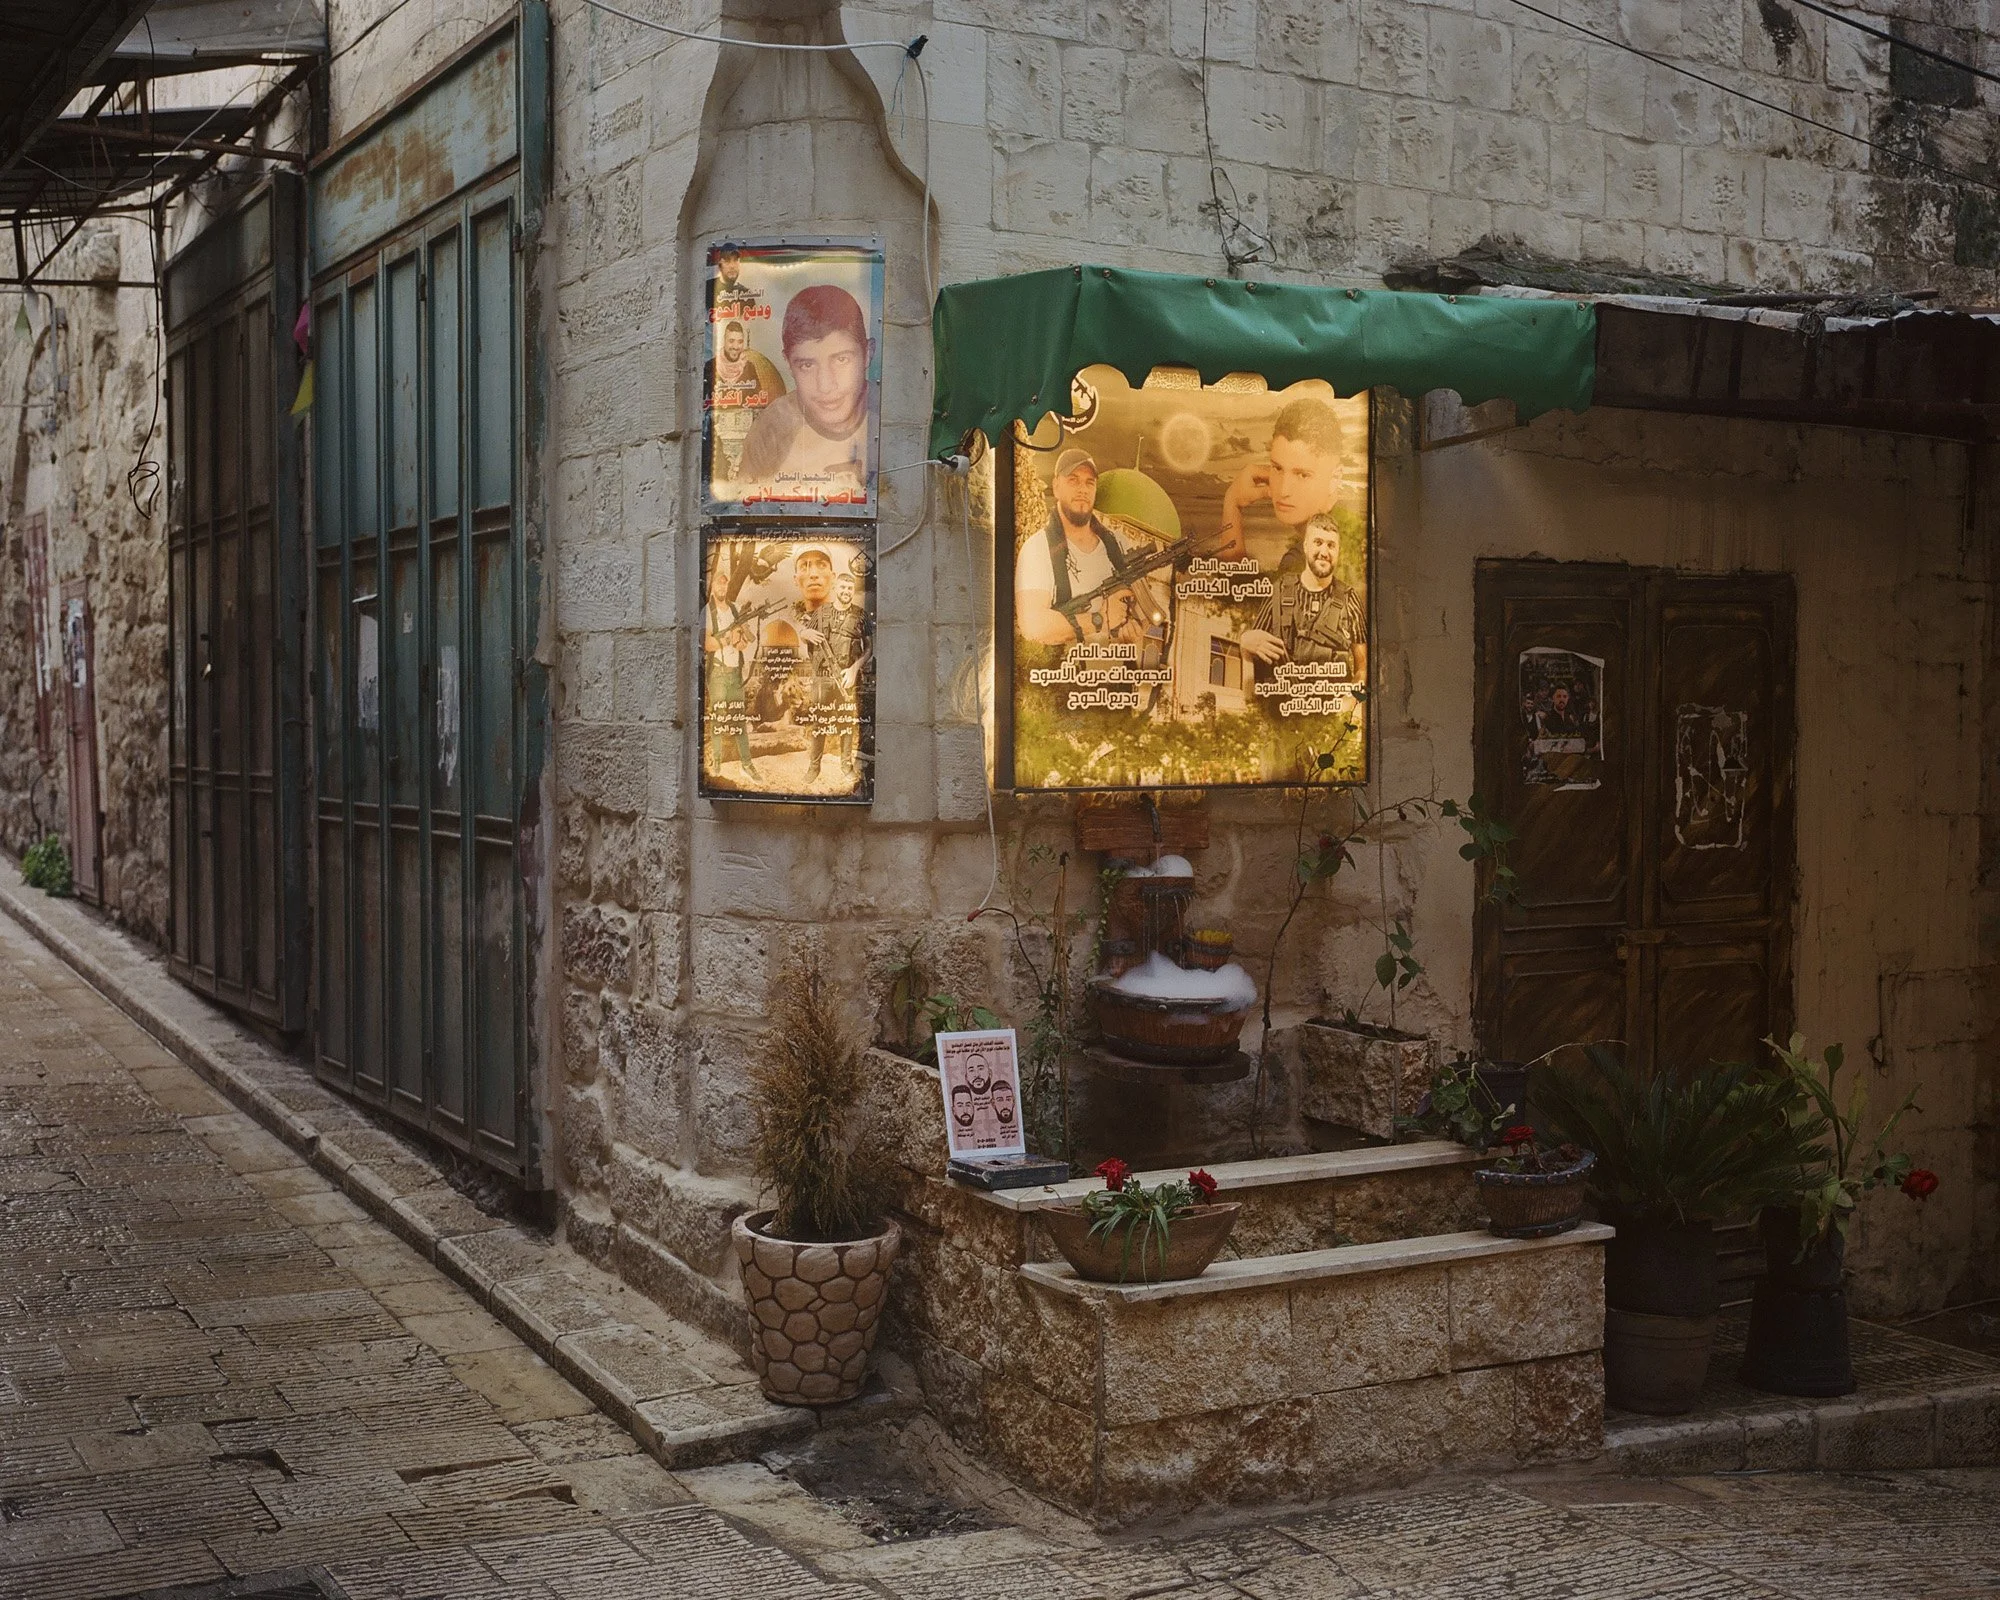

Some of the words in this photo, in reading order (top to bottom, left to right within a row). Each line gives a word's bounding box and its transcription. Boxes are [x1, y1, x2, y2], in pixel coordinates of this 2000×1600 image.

[743, 304, 772, 321] وديع
[742, 389, 769, 408] تامر
[775, 471, 801, 484] البطل
[802, 471, 835, 484] الشهيد
[742, 485, 819, 508] الكيلاني
[820, 486, 868, 508] ناصر
[1188, 557, 1218, 576] البطل
[1219, 557, 1259, 576] الشهيد
[1176, 578, 1230, 599] الكيلاني
[1231, 577, 1274, 601] شادي
[1068, 644, 1100, 664] العام
[1101, 644, 1137, 661] القائد
[1030, 662, 1076, 686] الأسود
[1077, 669, 1107, 686] عرين
[1108, 667, 1173, 686] لمجموعات
[1274, 662, 1317, 679] الميداني
[1318, 662, 1347, 677] القائد
[1291, 683, 1314, 697] عرين
[713, 701, 727, 711] العام
[728, 701, 745, 710] القائد
[808, 699, 837, 714] الميداني
[838, 702, 857, 712] القائد
[1067, 688, 1107, 710] الحوح
[1108, 691, 1140, 709] وديع
[1280, 697, 1321, 716] الكيلاني
[1324, 698, 1342, 715] تامر
[732, 713, 762, 724] لمجموعات
[818, 715, 837, 725] عرين
[837, 715, 871, 726] لمجموعات
[812, 724, 838, 738] الكيلاني
[840, 726, 853, 737] تامر
